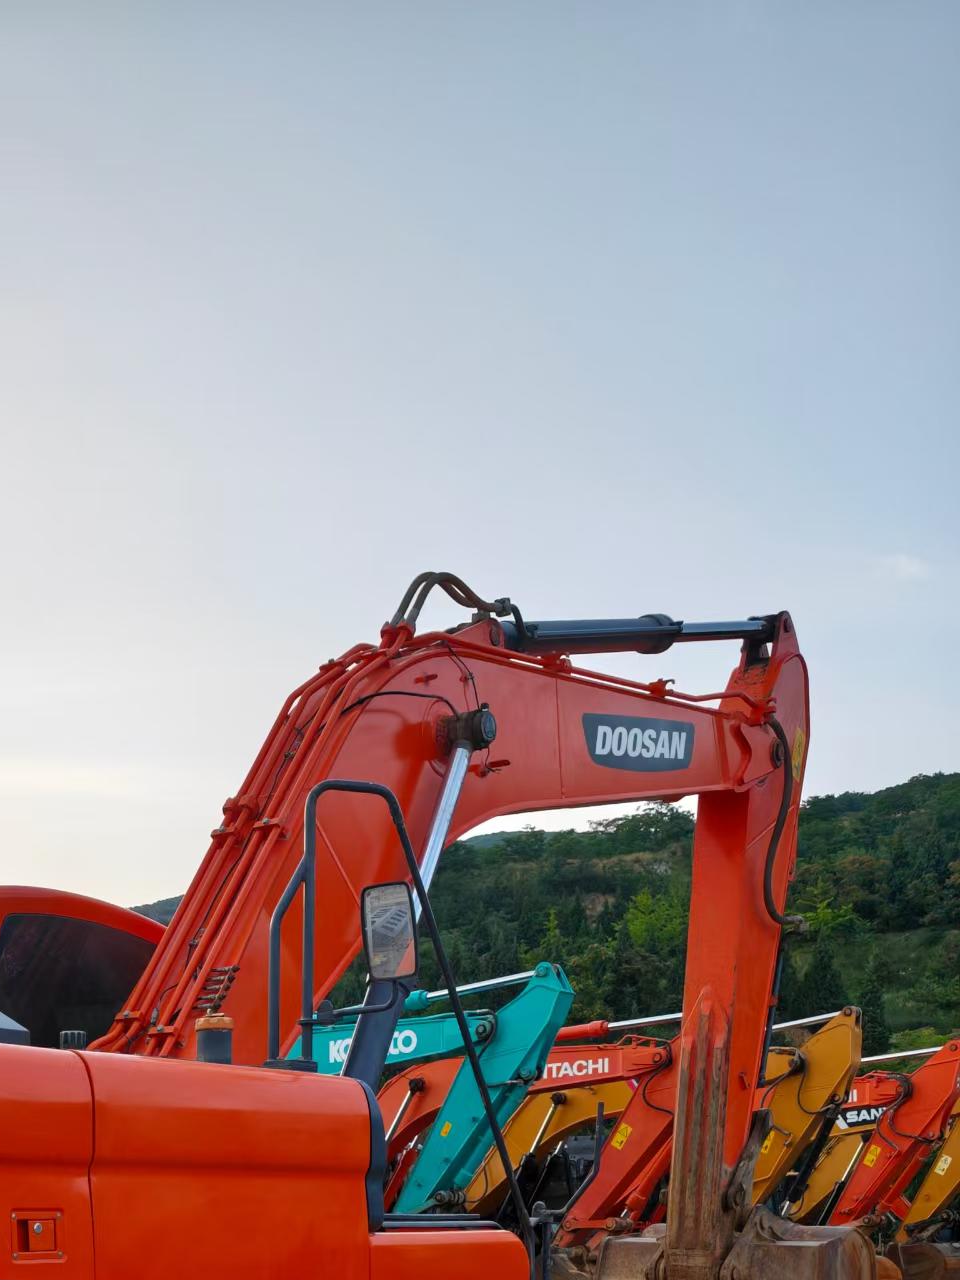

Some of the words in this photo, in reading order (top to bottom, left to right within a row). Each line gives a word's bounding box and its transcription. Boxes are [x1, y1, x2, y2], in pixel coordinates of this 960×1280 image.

[595, 725, 687, 760] DOOSAN
[329, 1030, 417, 1063] KOCO
[542, 1058, 609, 1079] ITACHI
[845, 1107, 887, 1123] SAN
